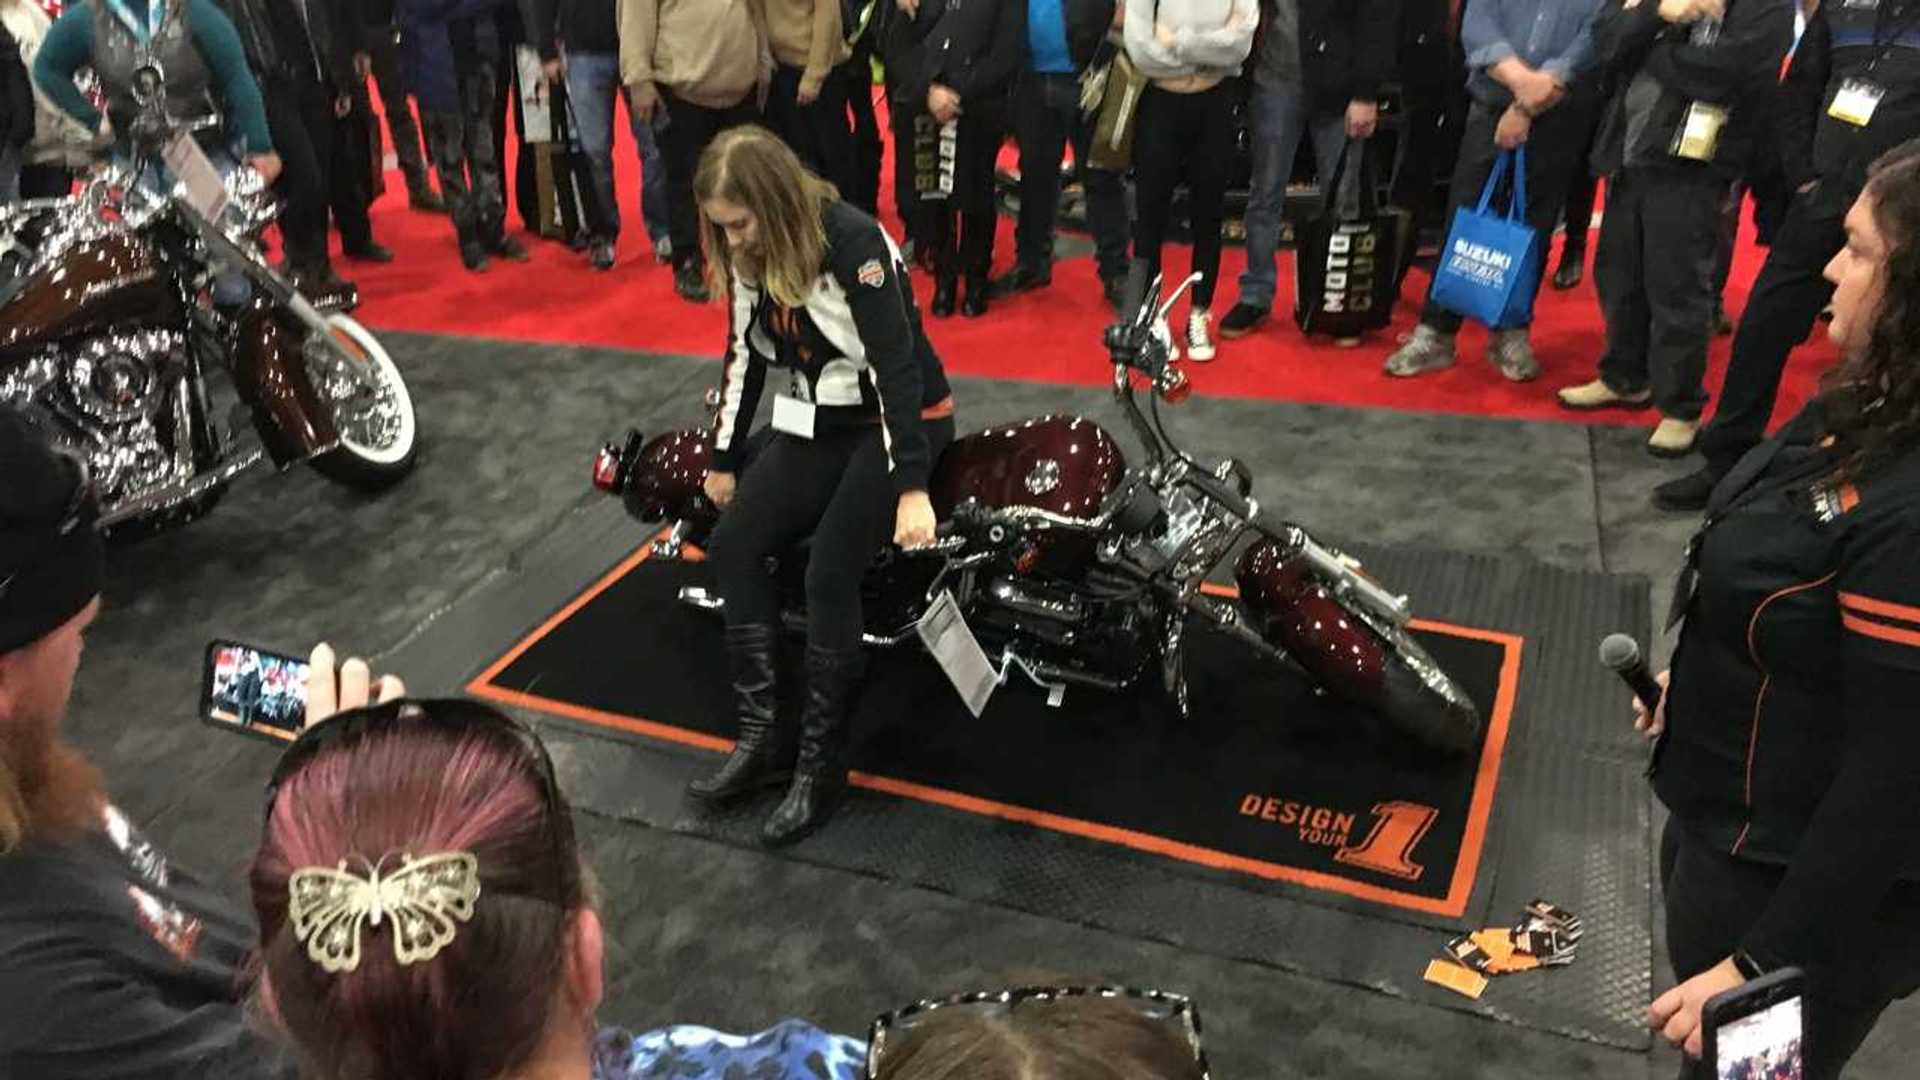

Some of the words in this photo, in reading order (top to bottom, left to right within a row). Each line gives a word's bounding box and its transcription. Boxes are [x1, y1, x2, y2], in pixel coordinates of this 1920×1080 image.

[1323, 233, 1350, 313] MOTO
[1349, 234, 1376, 312] CLUB
[1453, 237, 1512, 271] SUZUKI
[1239, 794, 1356, 833] DESIGN
[1299, 827, 1350, 848] YOUR
[1333, 802, 1439, 880] 1
